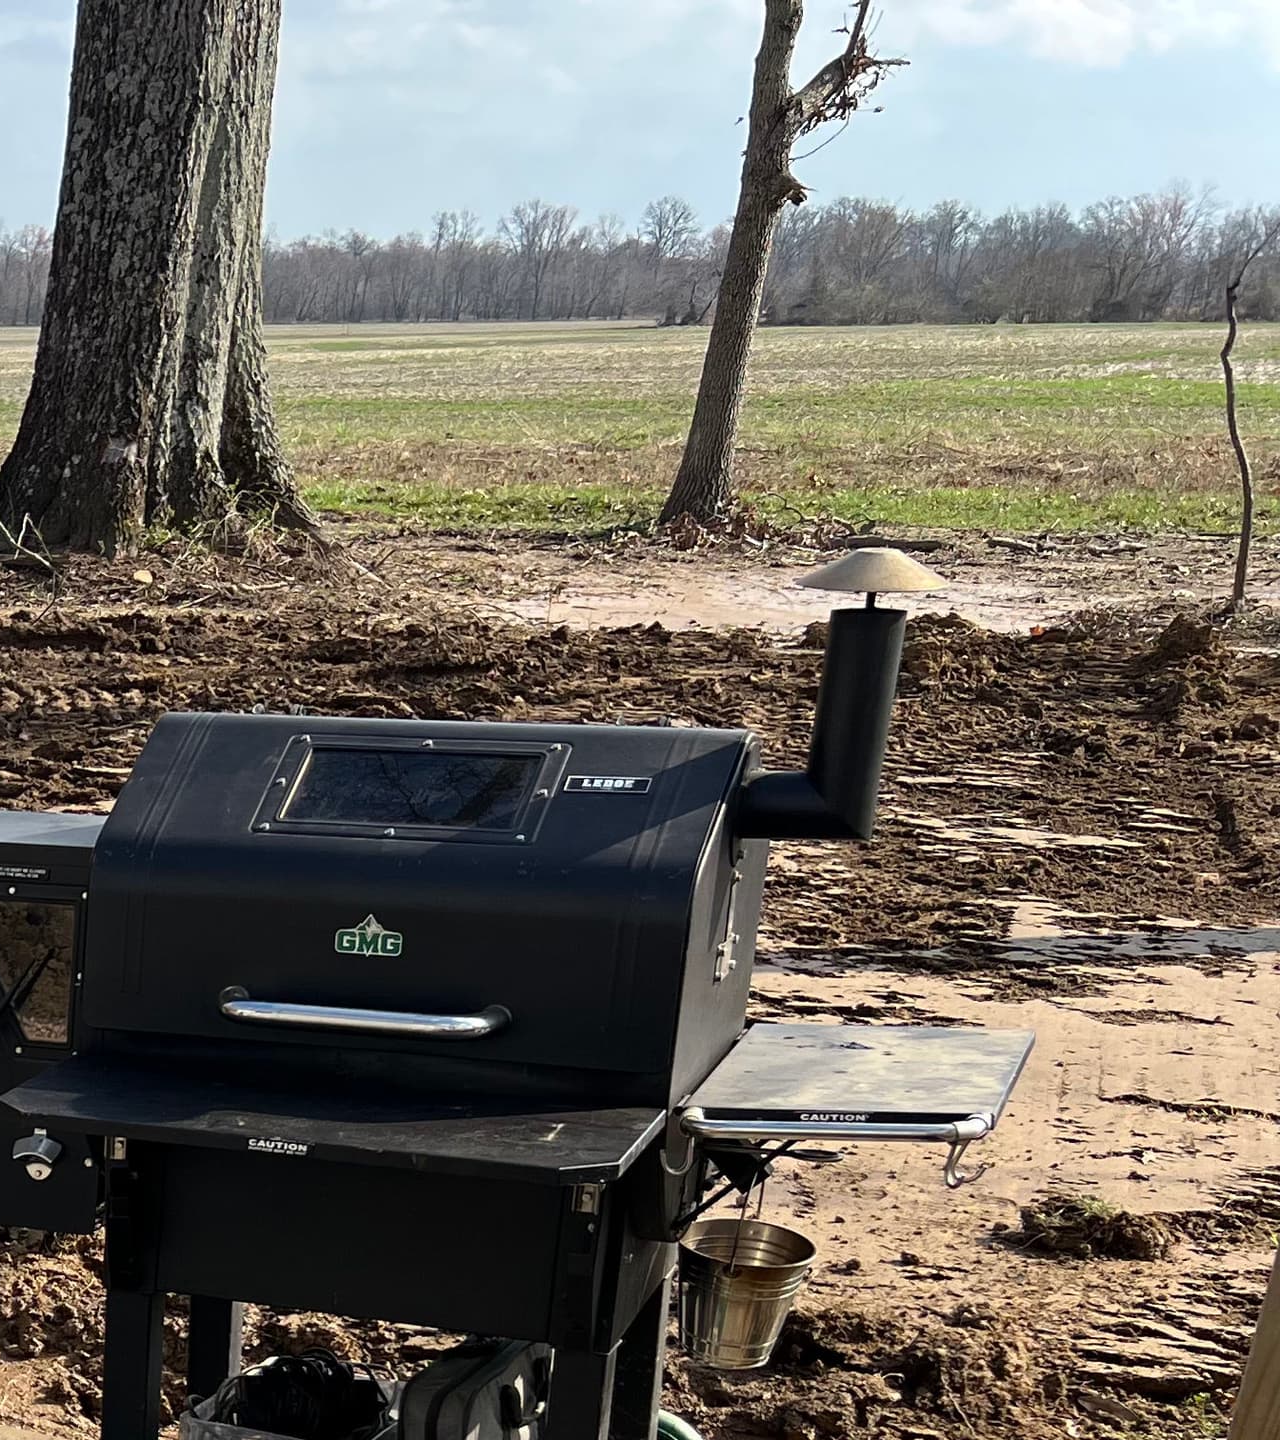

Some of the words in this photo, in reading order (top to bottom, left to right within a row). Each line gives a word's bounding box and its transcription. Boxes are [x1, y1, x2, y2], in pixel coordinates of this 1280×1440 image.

[335, 928, 403, 957] GMG
[799, 1113, 866, 1122] CAUTION
[248, 1138, 308, 1152] CAUTION
